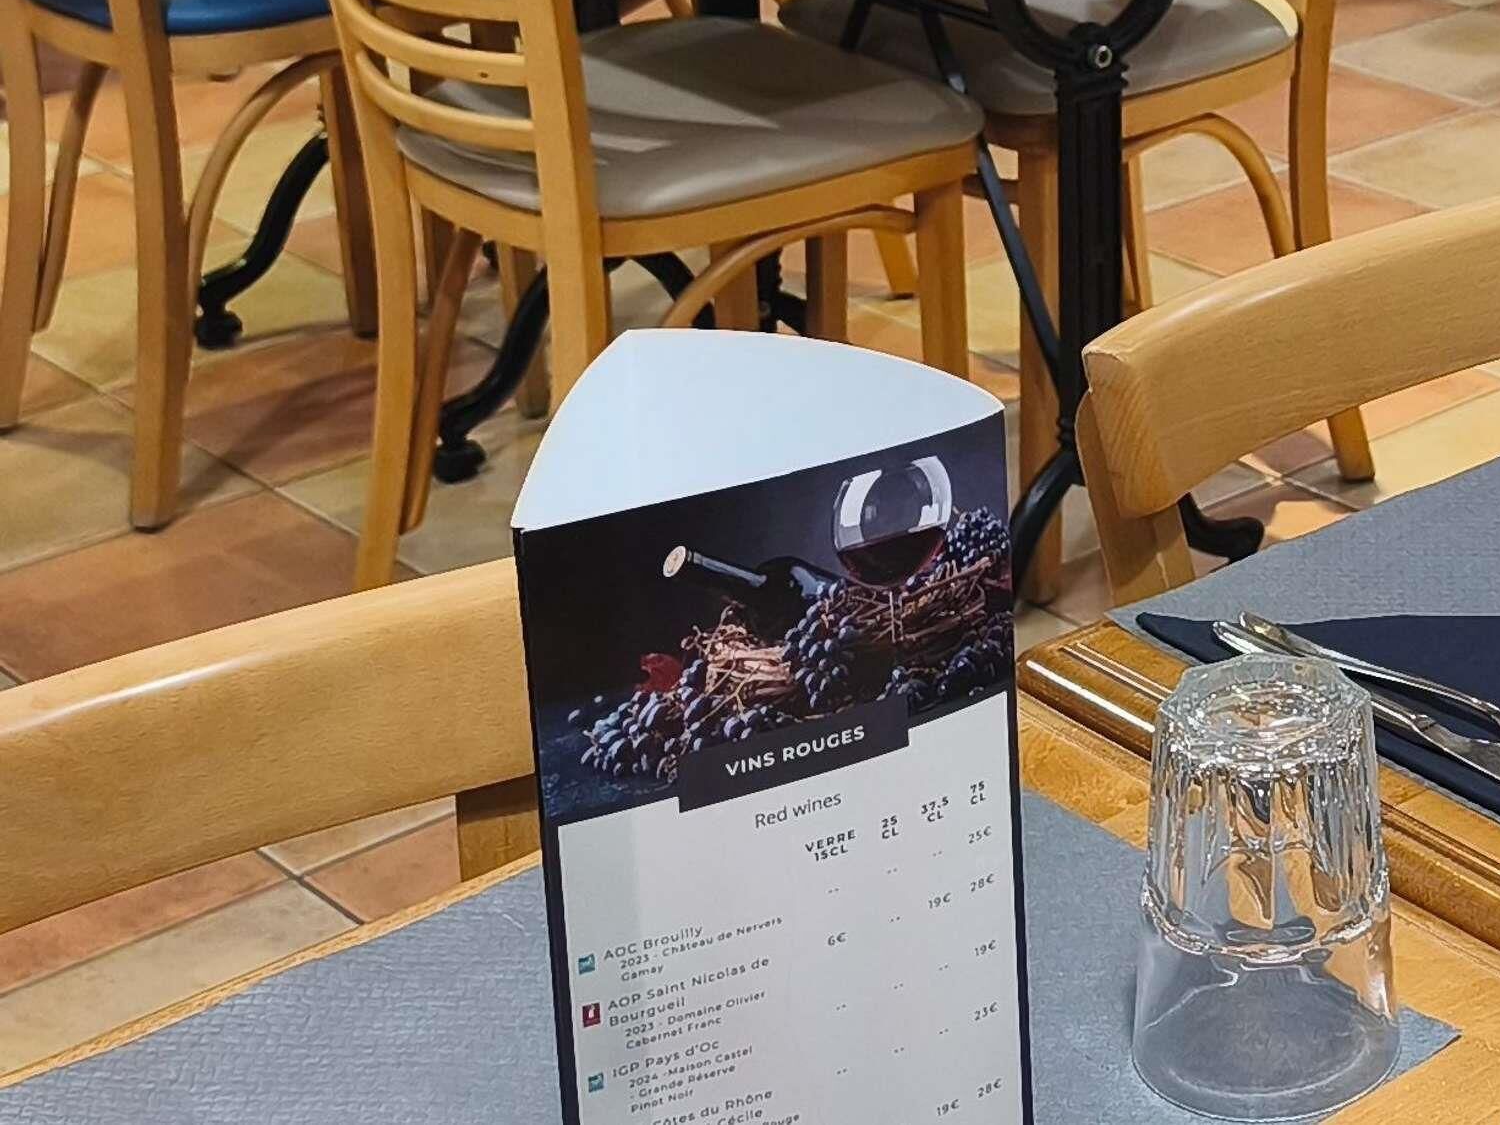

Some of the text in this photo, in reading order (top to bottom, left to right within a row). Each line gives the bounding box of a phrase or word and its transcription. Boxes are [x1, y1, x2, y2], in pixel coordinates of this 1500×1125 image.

[725, 725, 866, 776] VINS ROUGES
[969, 781, 986, 794] 75
[970, 793, 987, 806] CL
[755, 793, 842, 829] Red wines
[926, 810, 945, 823] CL
[881, 815, 899, 829] 25
[804, 829, 857, 853] VERRE
[881, 827, 900, 840] CL
[968, 826, 993, 844] 25€
[814, 844, 849, 862] 15CL
[970, 873, 995, 893] 28€
[927, 892, 952, 909] 19€
[603, 926, 704, 961] AOC Brouilly
[662, 937, 714, 957] Château
[717, 930, 733, 942] de
[827, 932, 847, 947] 6€
[974, 939, 998, 957] 19€
[621, 964, 664, 982] Gamay
[608, 957, 770, 1011] AOP Saint Nicolas de
[609, 996, 686, 1026] Bourgueil
[624, 1022, 655, 1038] 2023
[668, 1004, 722, 1026] Domaine
[726, 991, 767, 1009] Olivier
[626, 1016, 722, 1050] Cabernet Franc
[612, 1061, 641, 1078] IGP
[645, 1052, 681, 1069] Pays
[629, 1074, 659, 1089] 2024
[715, 1046, 753, 1064] Castel
[639, 1079, 684, 1098] Grande
[977, 1078, 1002, 1098] 28€
[631, 1089, 695, 1113] Pinot Noir
[700, 1106, 720, 1118] du
[725, 1090, 773, 1110] Rhône
[936, 1099, 960, 1117] 19€
